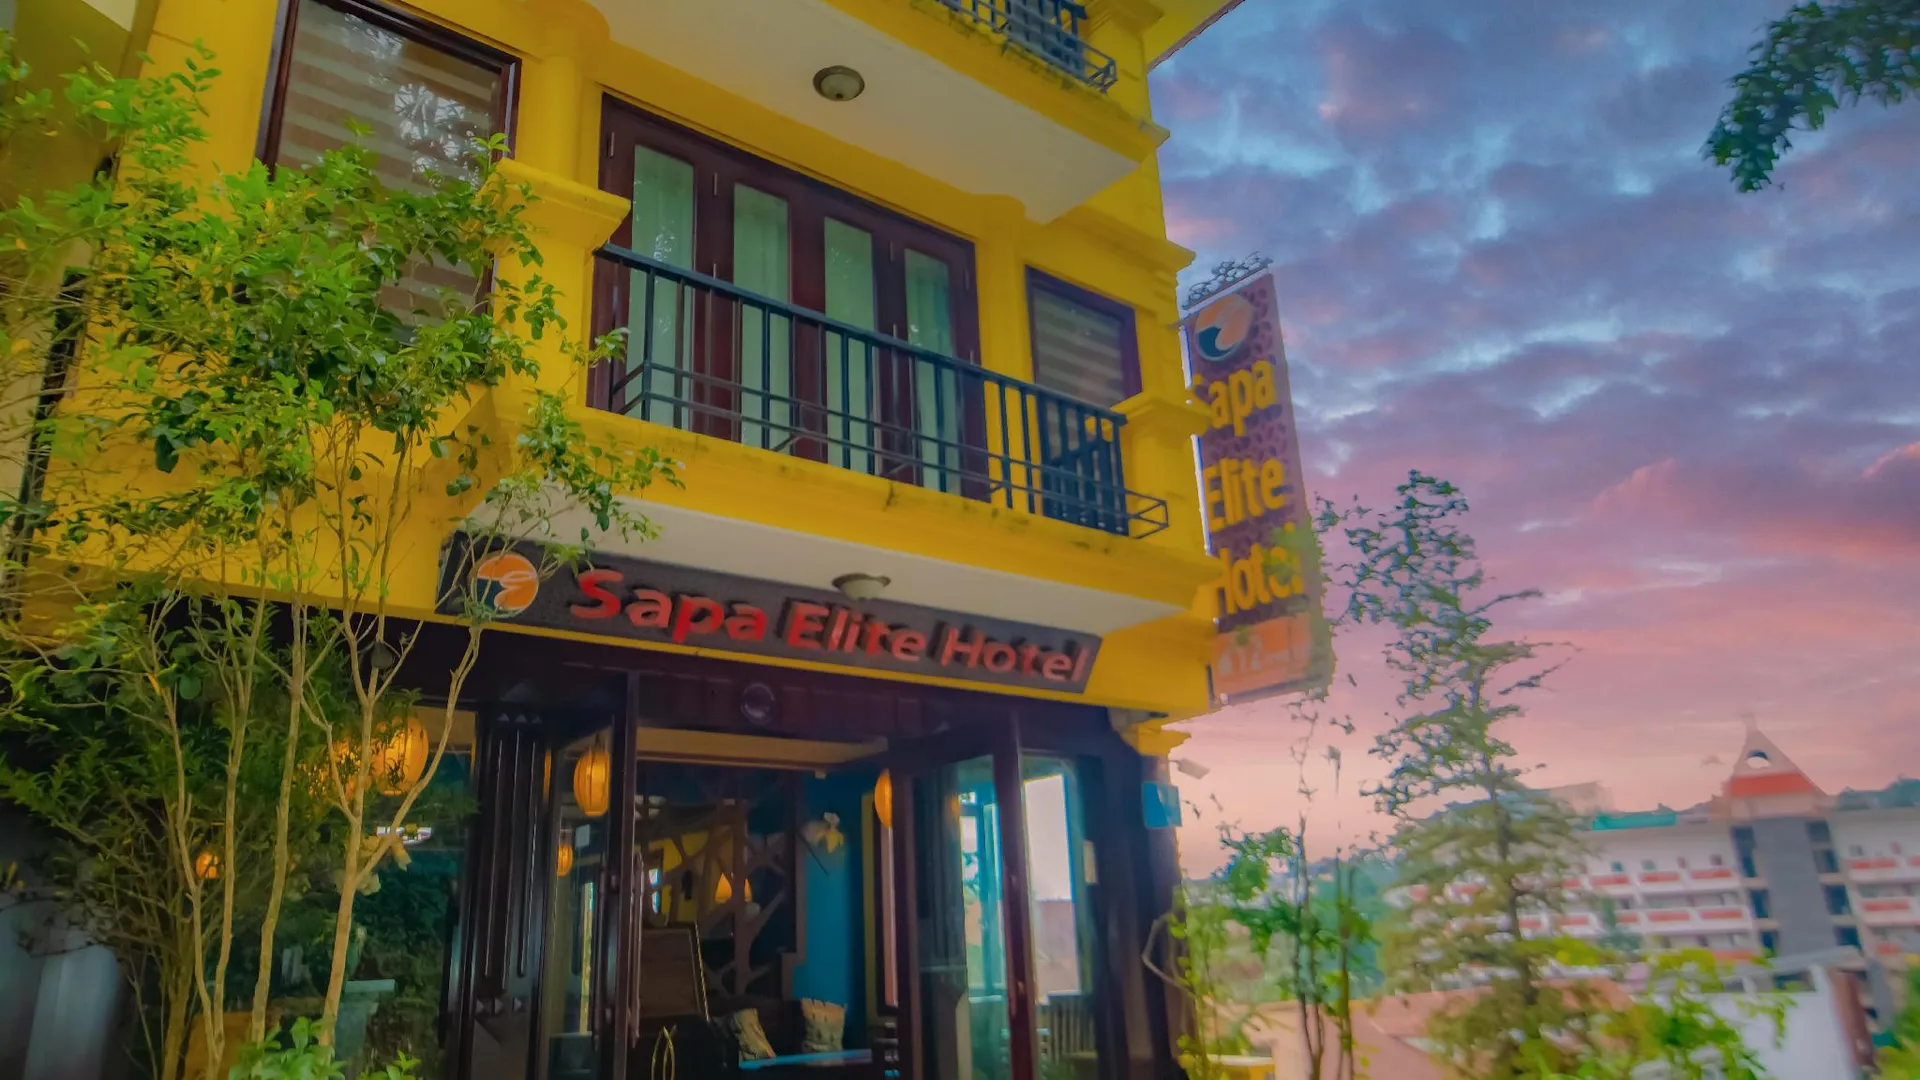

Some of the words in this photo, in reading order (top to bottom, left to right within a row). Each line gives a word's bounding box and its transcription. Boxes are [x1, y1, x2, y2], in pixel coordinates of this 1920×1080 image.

[1203, 458, 1286, 532] Elite
[570, 569, 768, 643] Sapa
[786, 602, 927, 662] Elite
[940, 626, 1090, 682] Hotel
